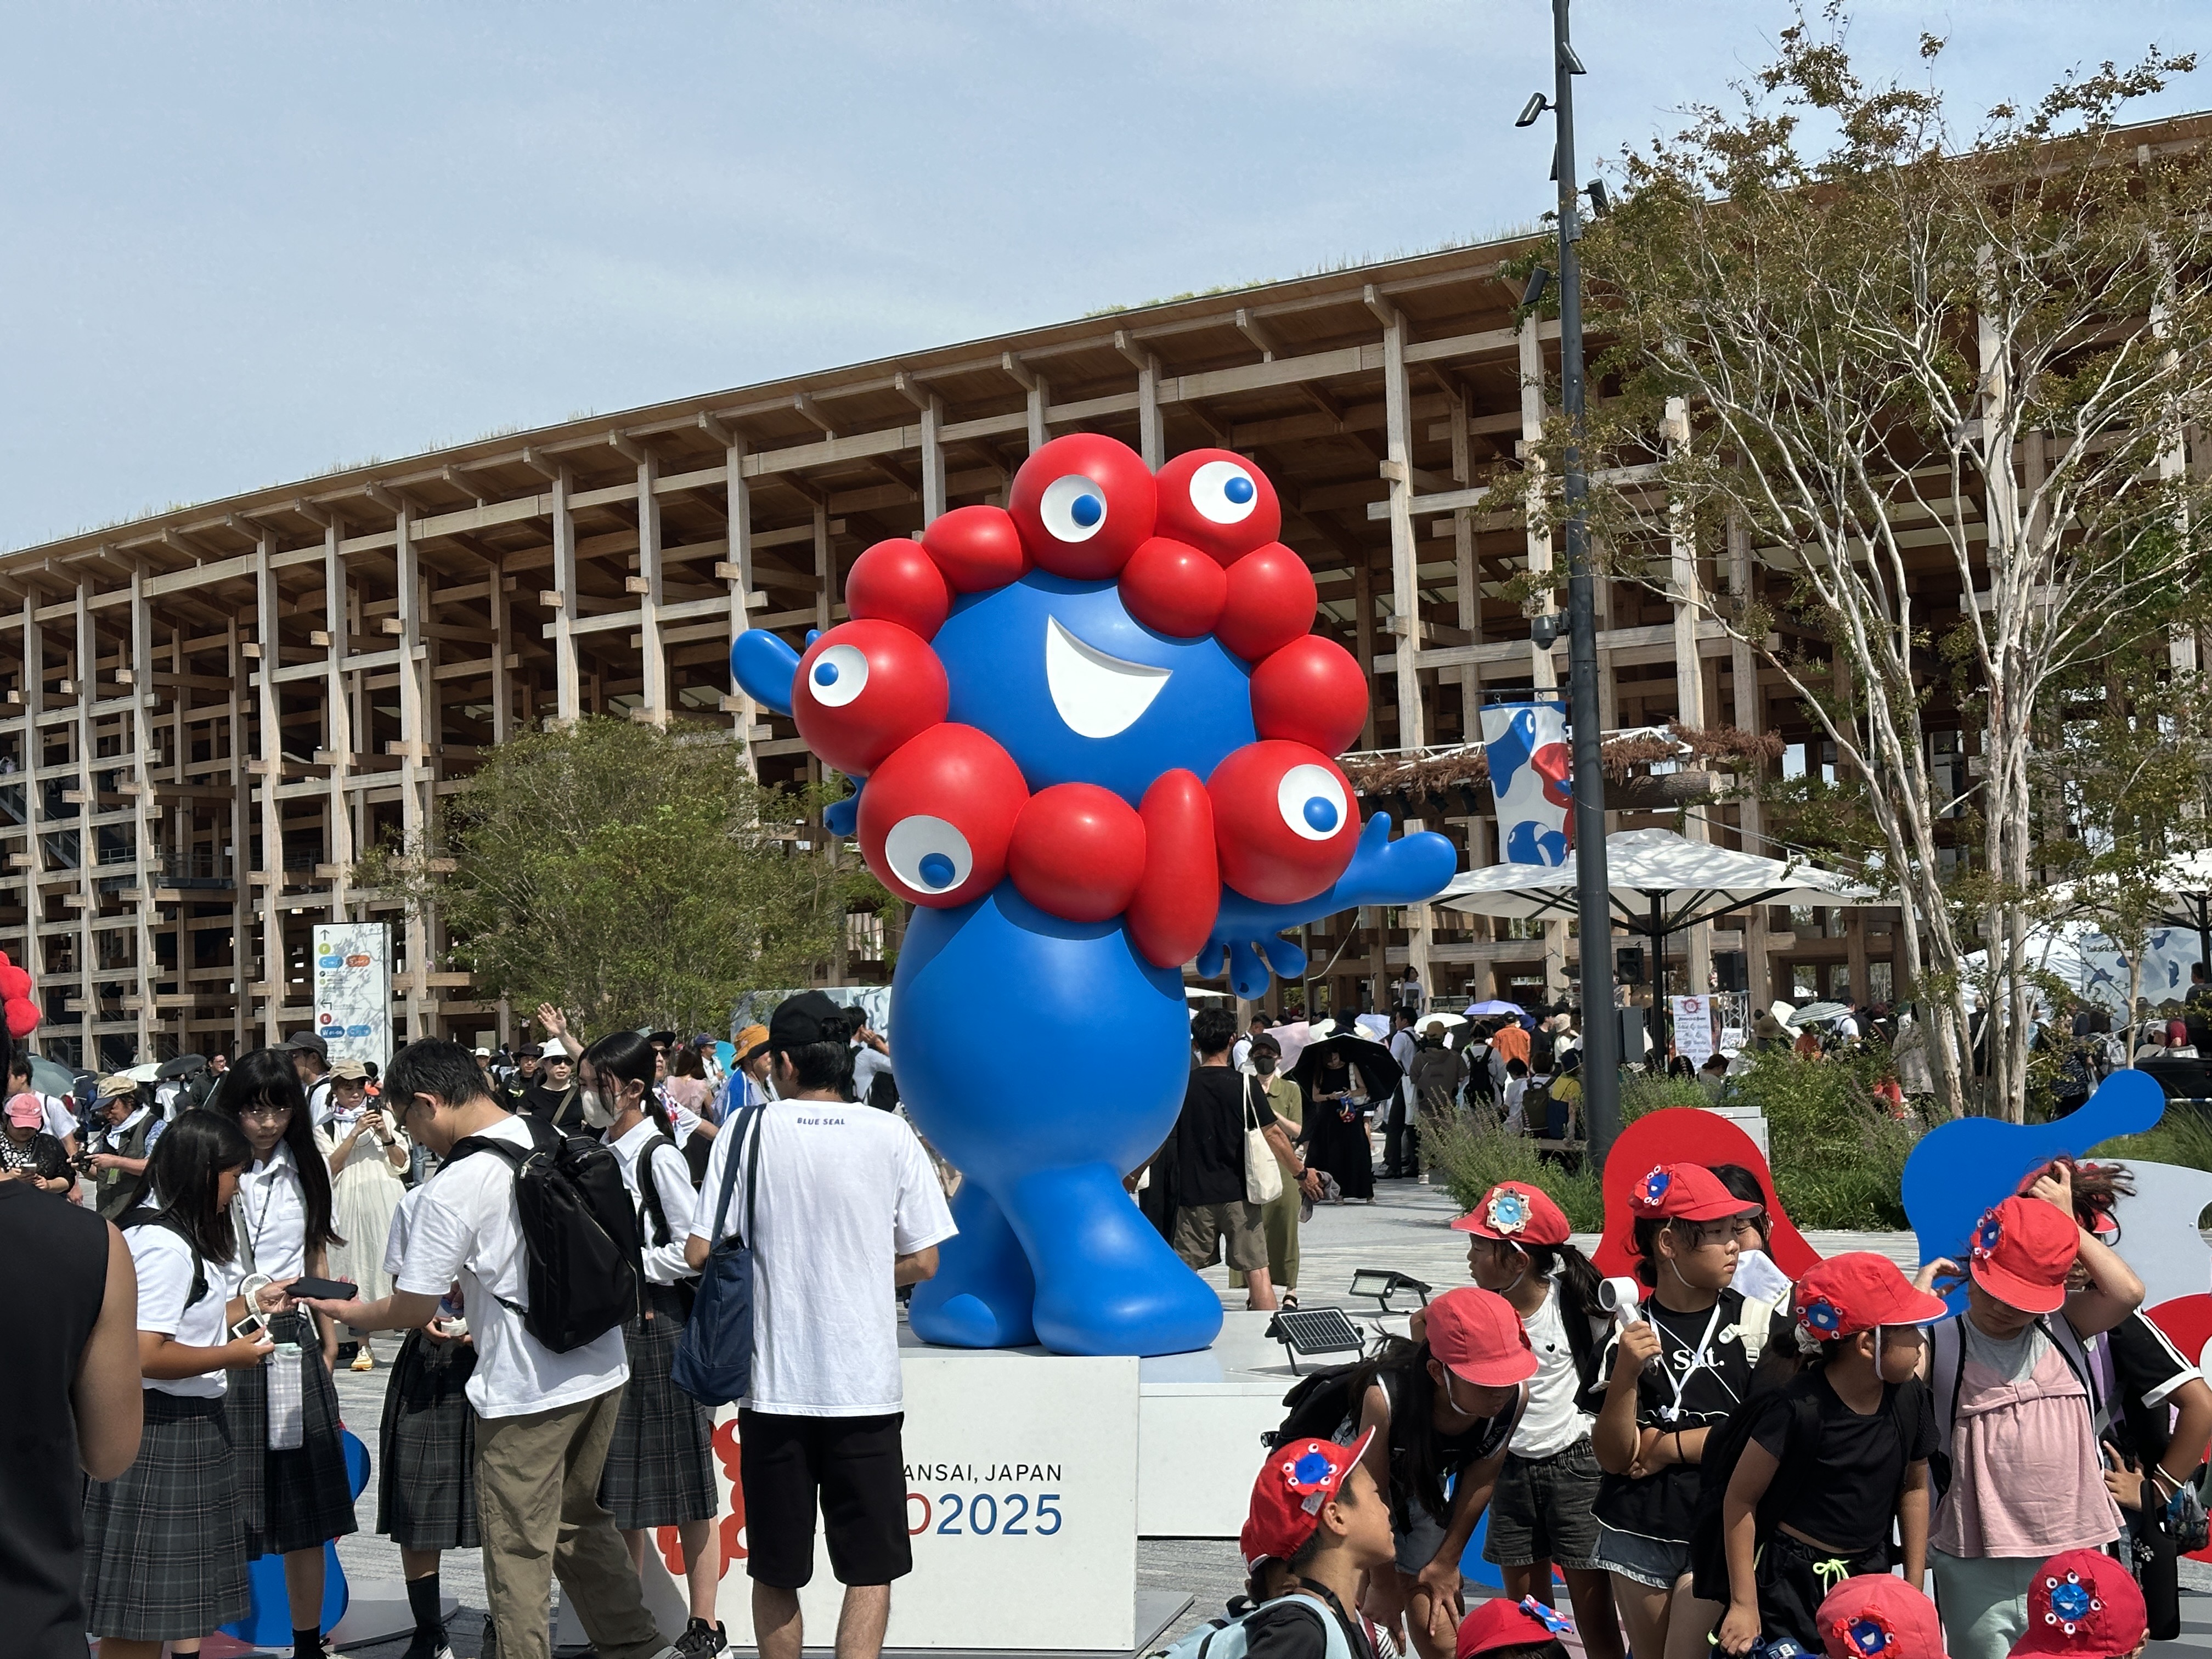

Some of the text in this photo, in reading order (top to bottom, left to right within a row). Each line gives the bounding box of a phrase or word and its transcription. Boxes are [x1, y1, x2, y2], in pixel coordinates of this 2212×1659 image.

[797, 1117, 820, 1125] BLUE
[905, 1464, 1061, 1483] ANSAI, JAPAN
[907, 1493, 1062, 1535] O2025
